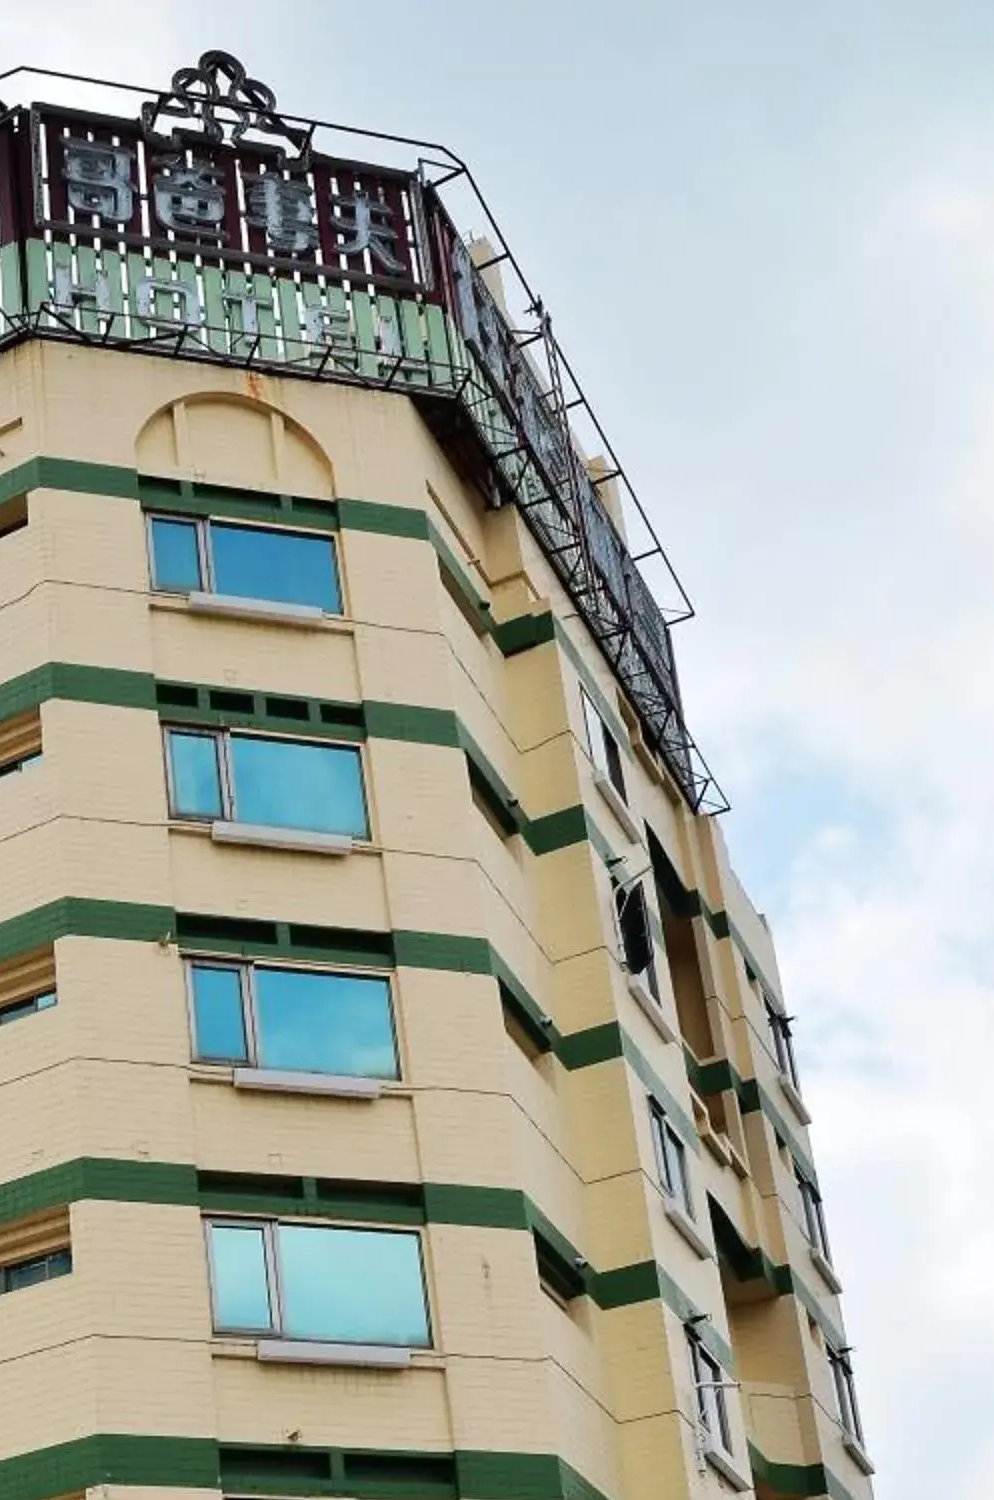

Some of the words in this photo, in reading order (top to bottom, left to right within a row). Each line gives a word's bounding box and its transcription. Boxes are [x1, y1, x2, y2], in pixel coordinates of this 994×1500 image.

[61, 136, 405, 274] 哥爸妻夫
[51, 263, 430, 380] HOTEL
